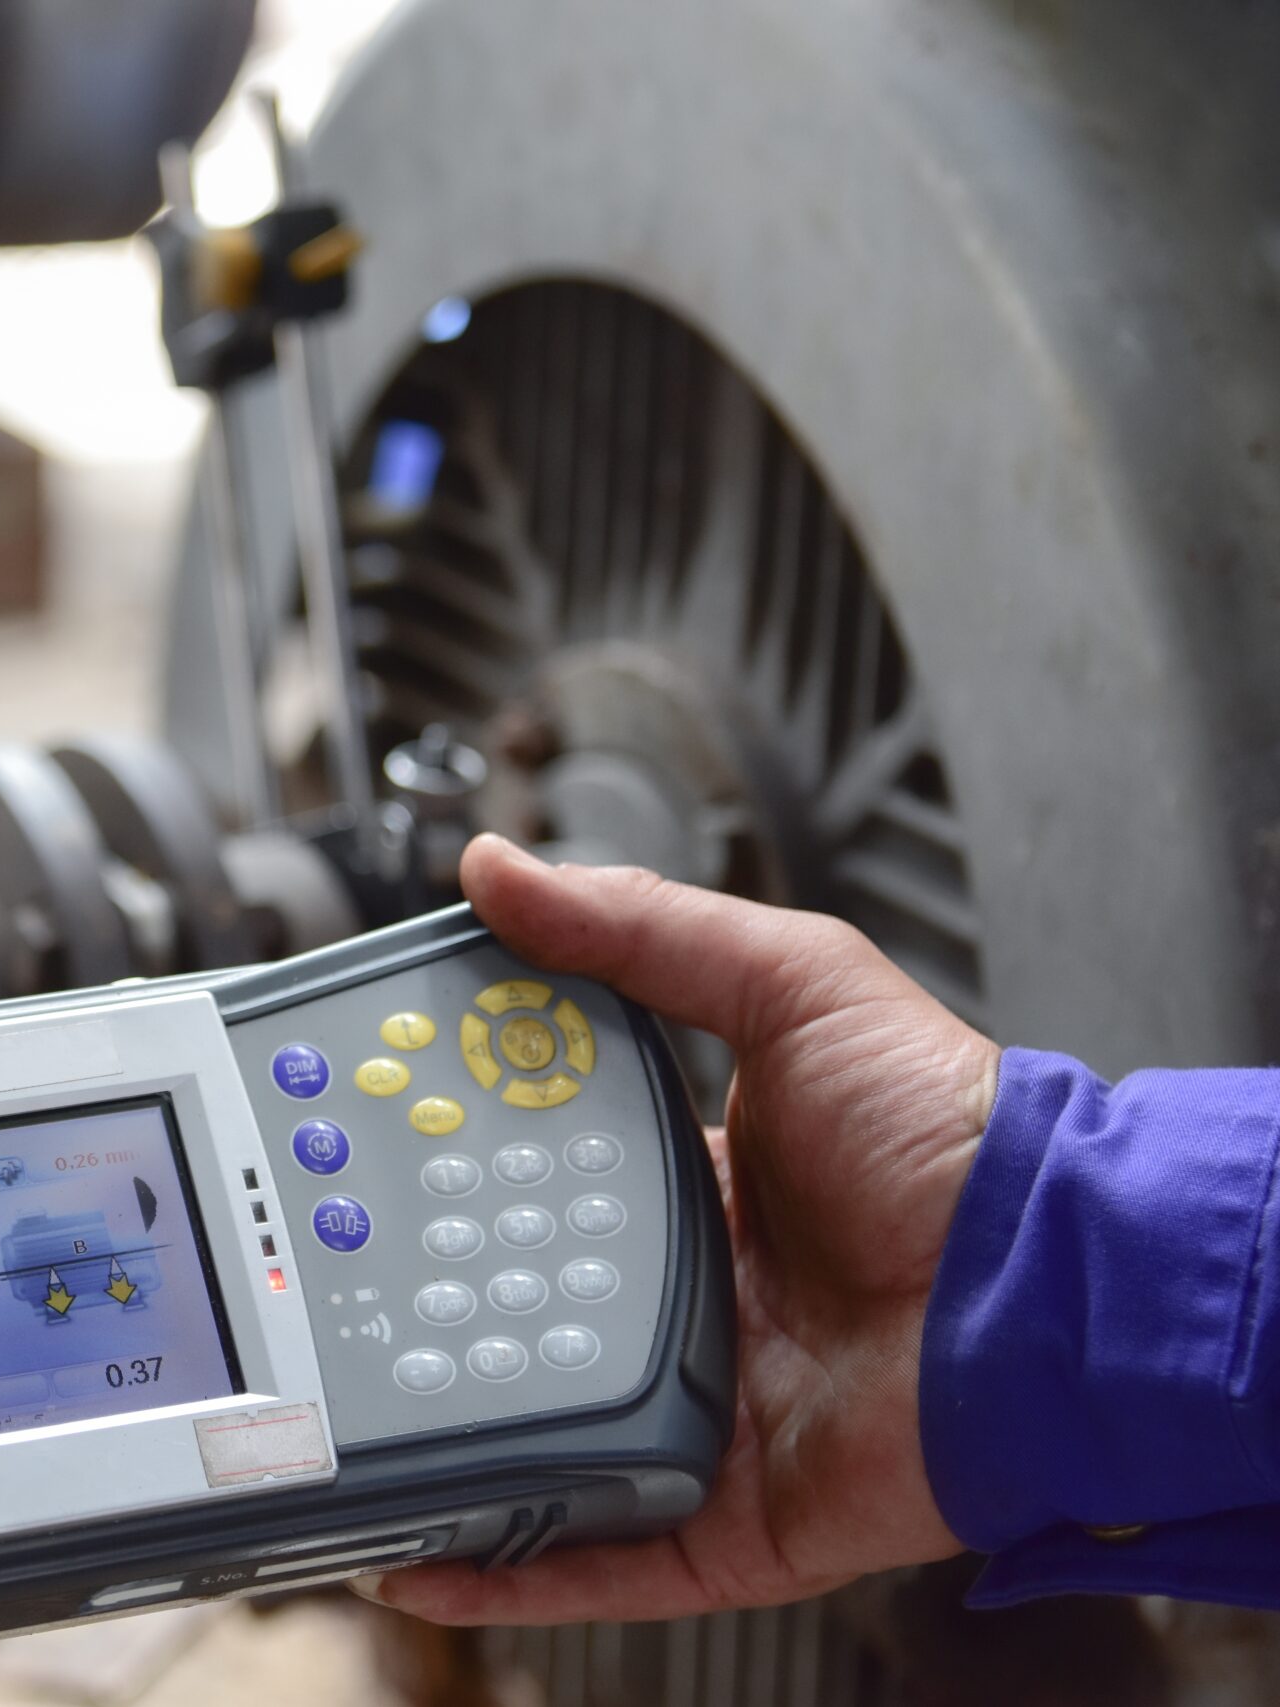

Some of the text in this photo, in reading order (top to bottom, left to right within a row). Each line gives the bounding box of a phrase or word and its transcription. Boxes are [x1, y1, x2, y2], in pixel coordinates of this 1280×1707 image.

[285, 1059, 318, 1076] DIM
[366, 1070, 400, 1086] CLR
[415, 1109, 457, 1125] Menu
[54, 1152, 99, 1172] 0.26
[73, 1240, 88, 1255] B
[105, 1356, 163, 1388] 0.37
